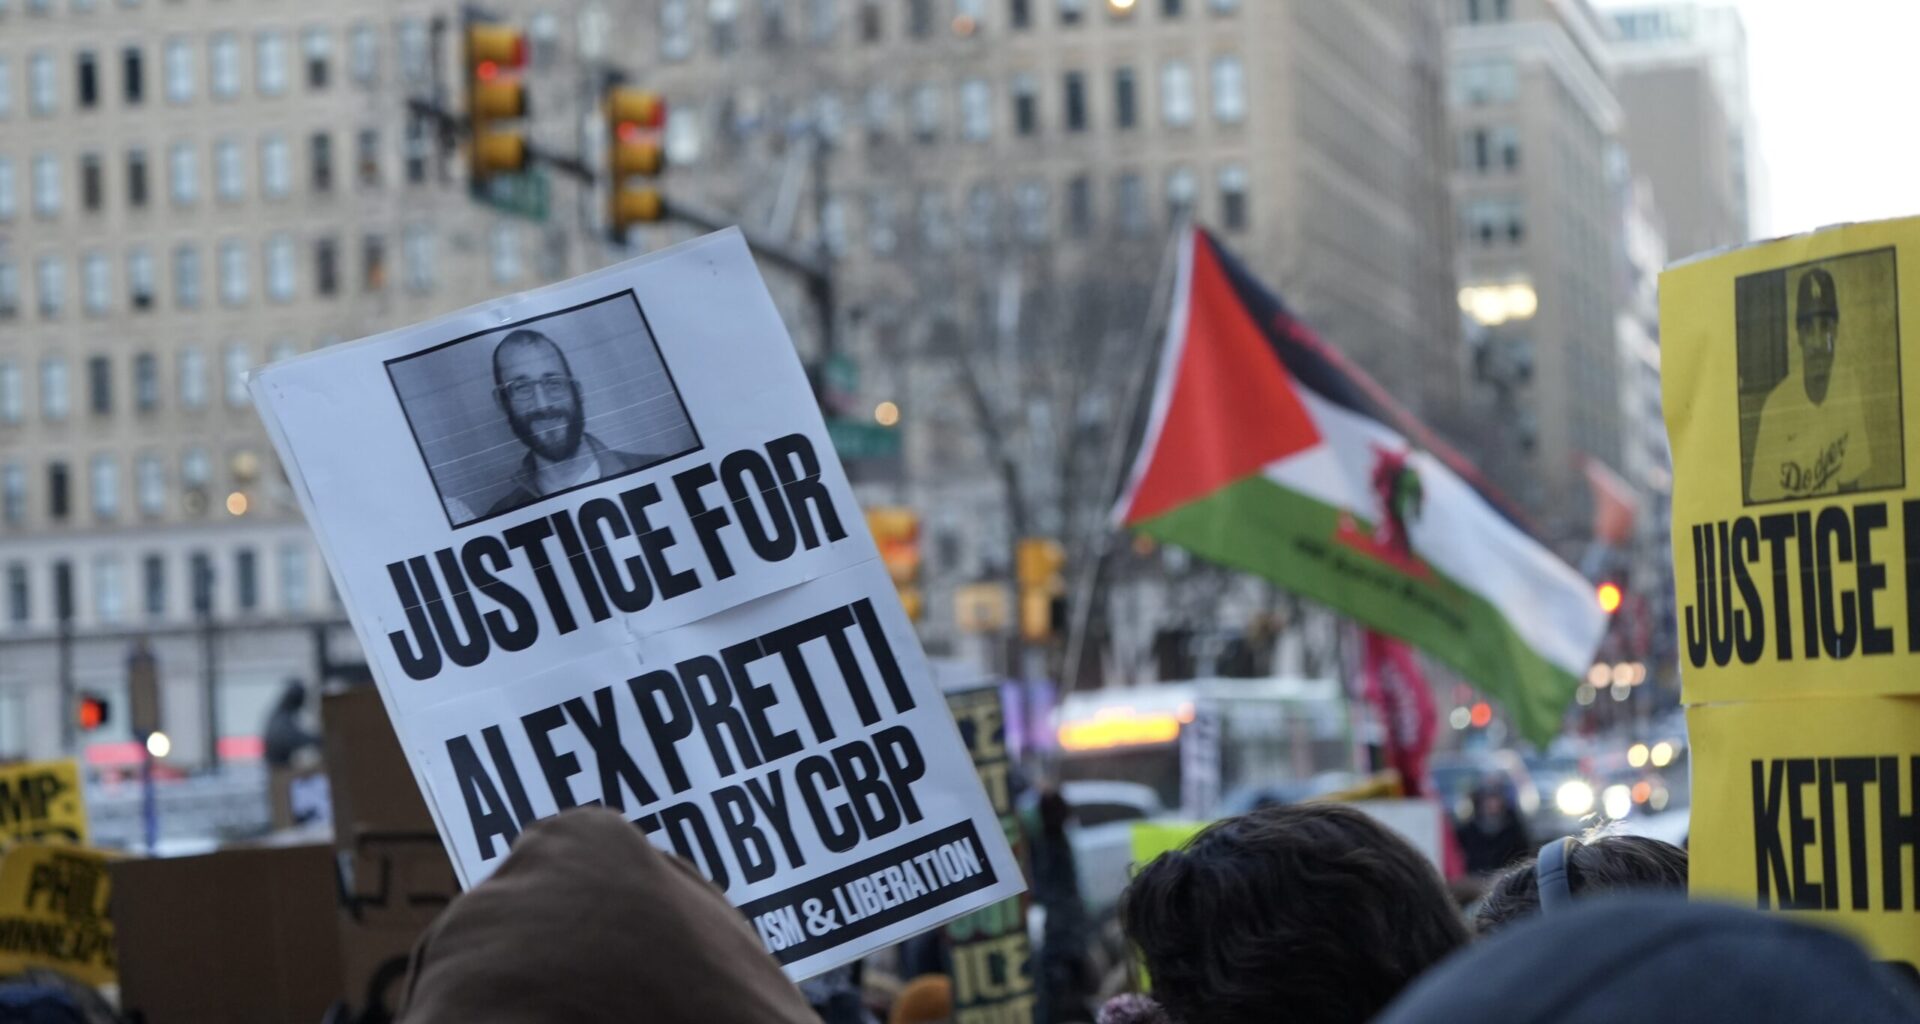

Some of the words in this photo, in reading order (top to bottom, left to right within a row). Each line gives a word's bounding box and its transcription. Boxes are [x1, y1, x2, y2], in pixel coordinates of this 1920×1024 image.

[387, 483, 702, 681] JUSTICE
[672, 433, 848, 581] FOR
[1685, 502, 1894, 668] JUSTICE
[627, 598, 916, 794] PRETTI
[711, 770, 806, 885] BY
[795, 725, 926, 854] CBP
[1751, 755, 1920, 912] KEITH
[802, 897, 840, 938] &
[832, 837, 984, 925] LIBERATION
